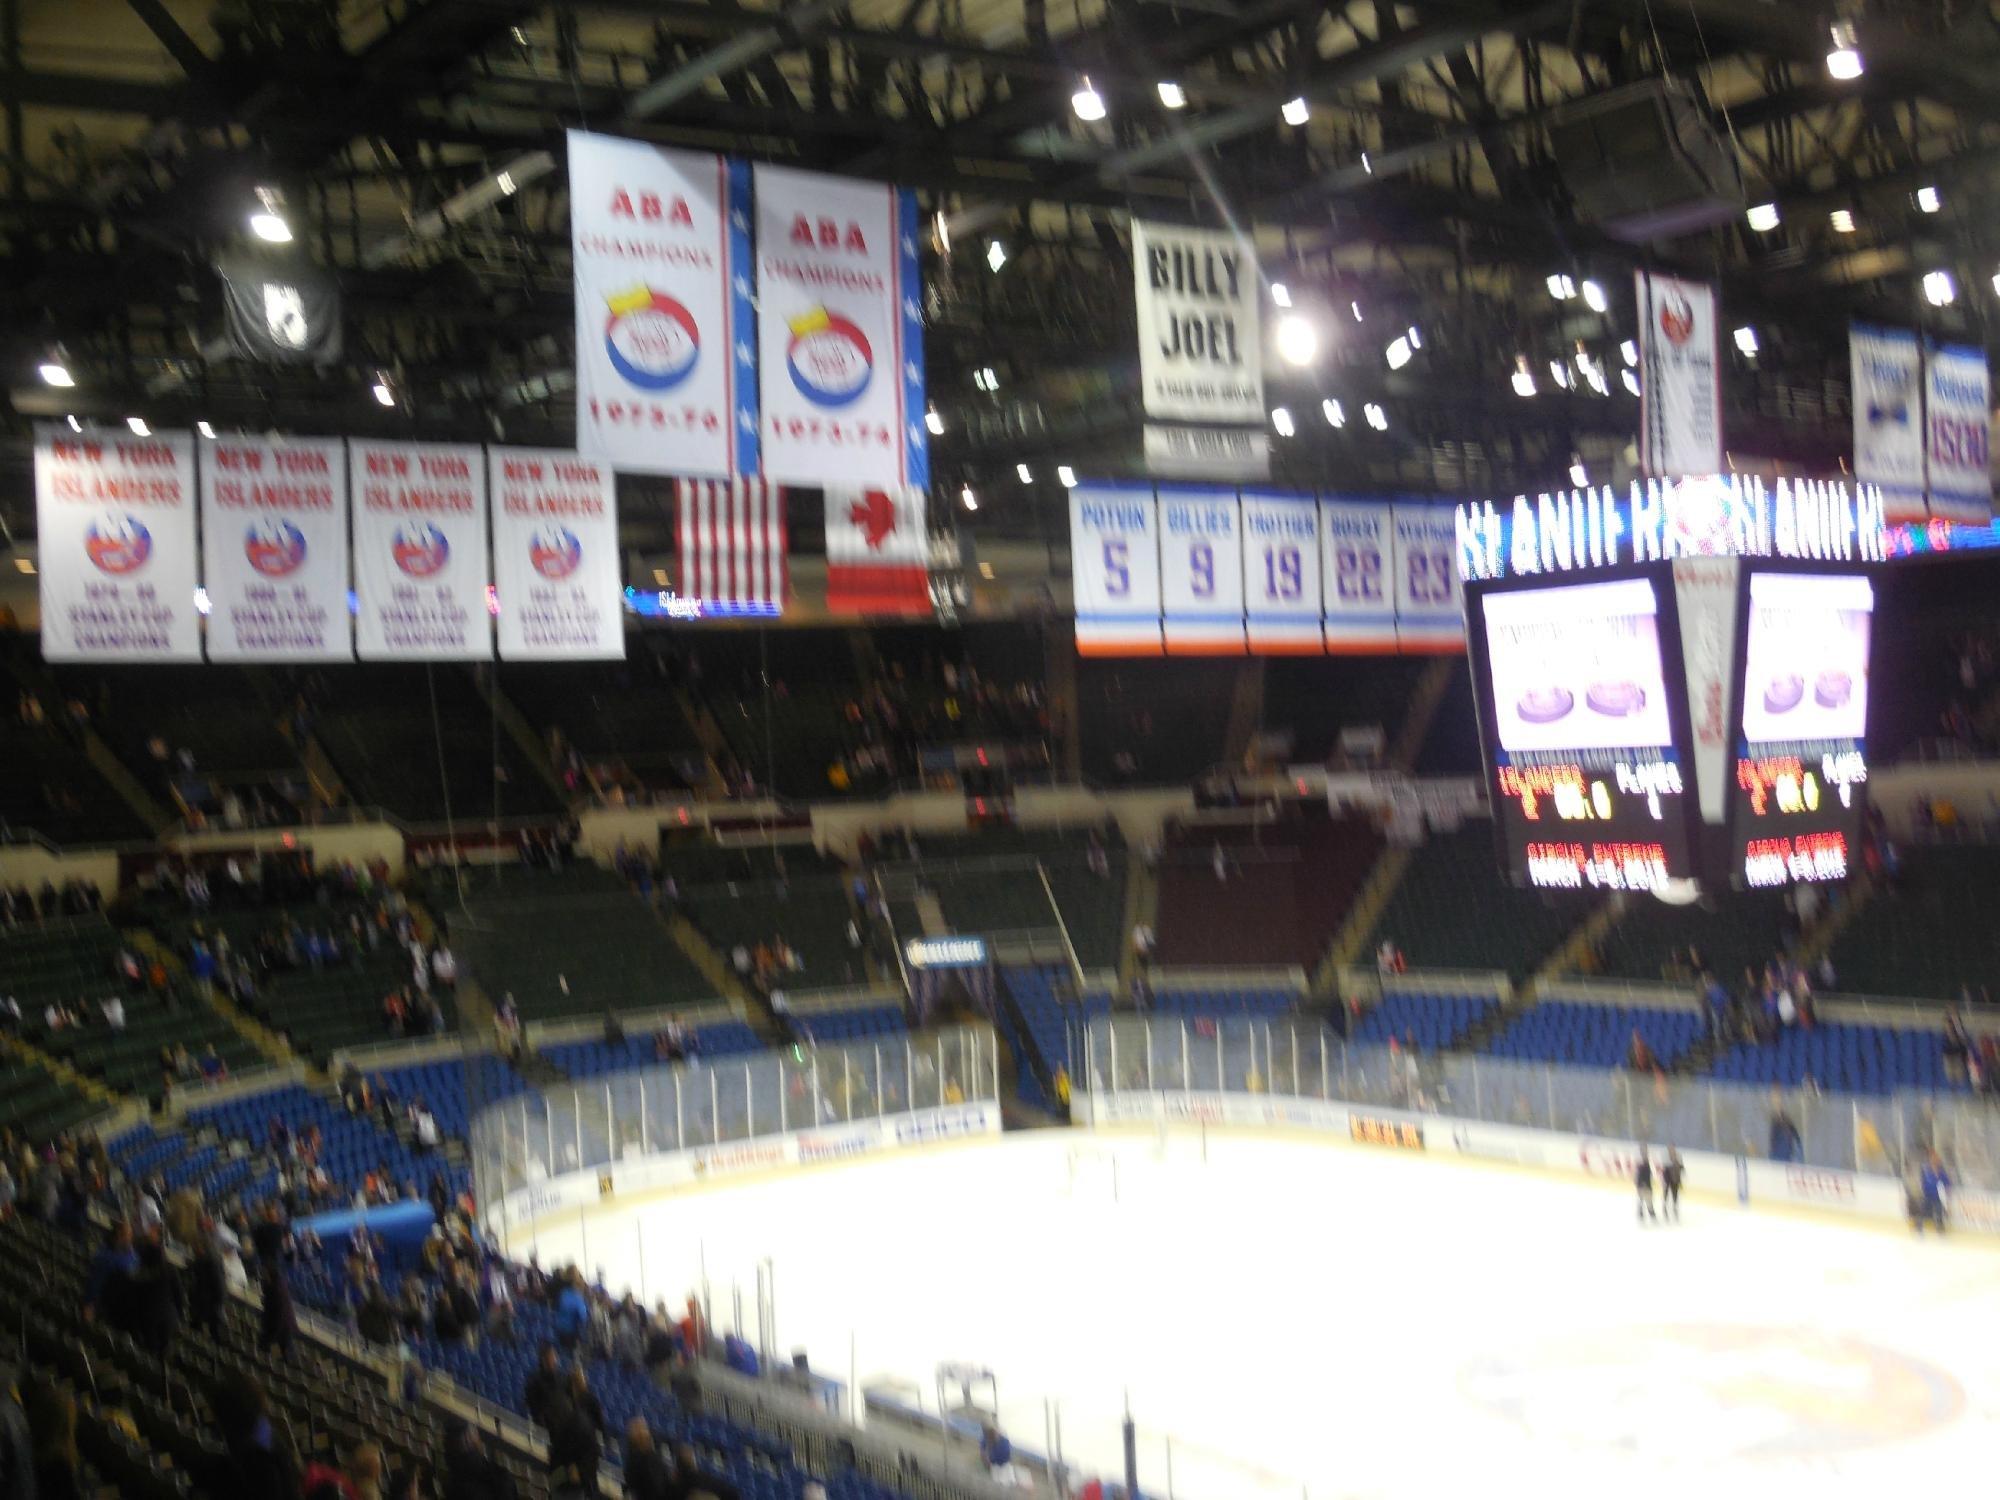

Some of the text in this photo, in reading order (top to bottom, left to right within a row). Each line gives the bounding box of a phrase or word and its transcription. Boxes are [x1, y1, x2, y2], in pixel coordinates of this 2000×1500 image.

[608, 186, 695, 230] ABA
[580, 233, 713, 271] CHAMPIONS
[790, 213, 869, 256] ABA
[763, 257, 886, 294] CHAMPIONS
[1148, 243, 1241, 300] BILLY
[1160, 312, 1243, 366] JOEL
[53, 437, 177, 469] NEW YORK
[215, 443, 329, 476] NEW YORK
[366, 451, 471, 481] NEW YORK
[503, 457, 600, 484] NEW YORK
[53, 472, 182, 510] ISLANDERS
[214, 478, 334, 512] ISLANDERS
[365, 484, 473, 515] ISLANDERS
[503, 488, 604, 518] ISLANDERS
[1081, 501, 1146, 534] POTVIN
[1103, 537, 1130, 600] 5
[1189, 541, 1214, 599] 9
[1265, 544, 1303, 603] 19
[1337, 546, 1384, 604] 22
[1408, 549, 1453, 604] 23
